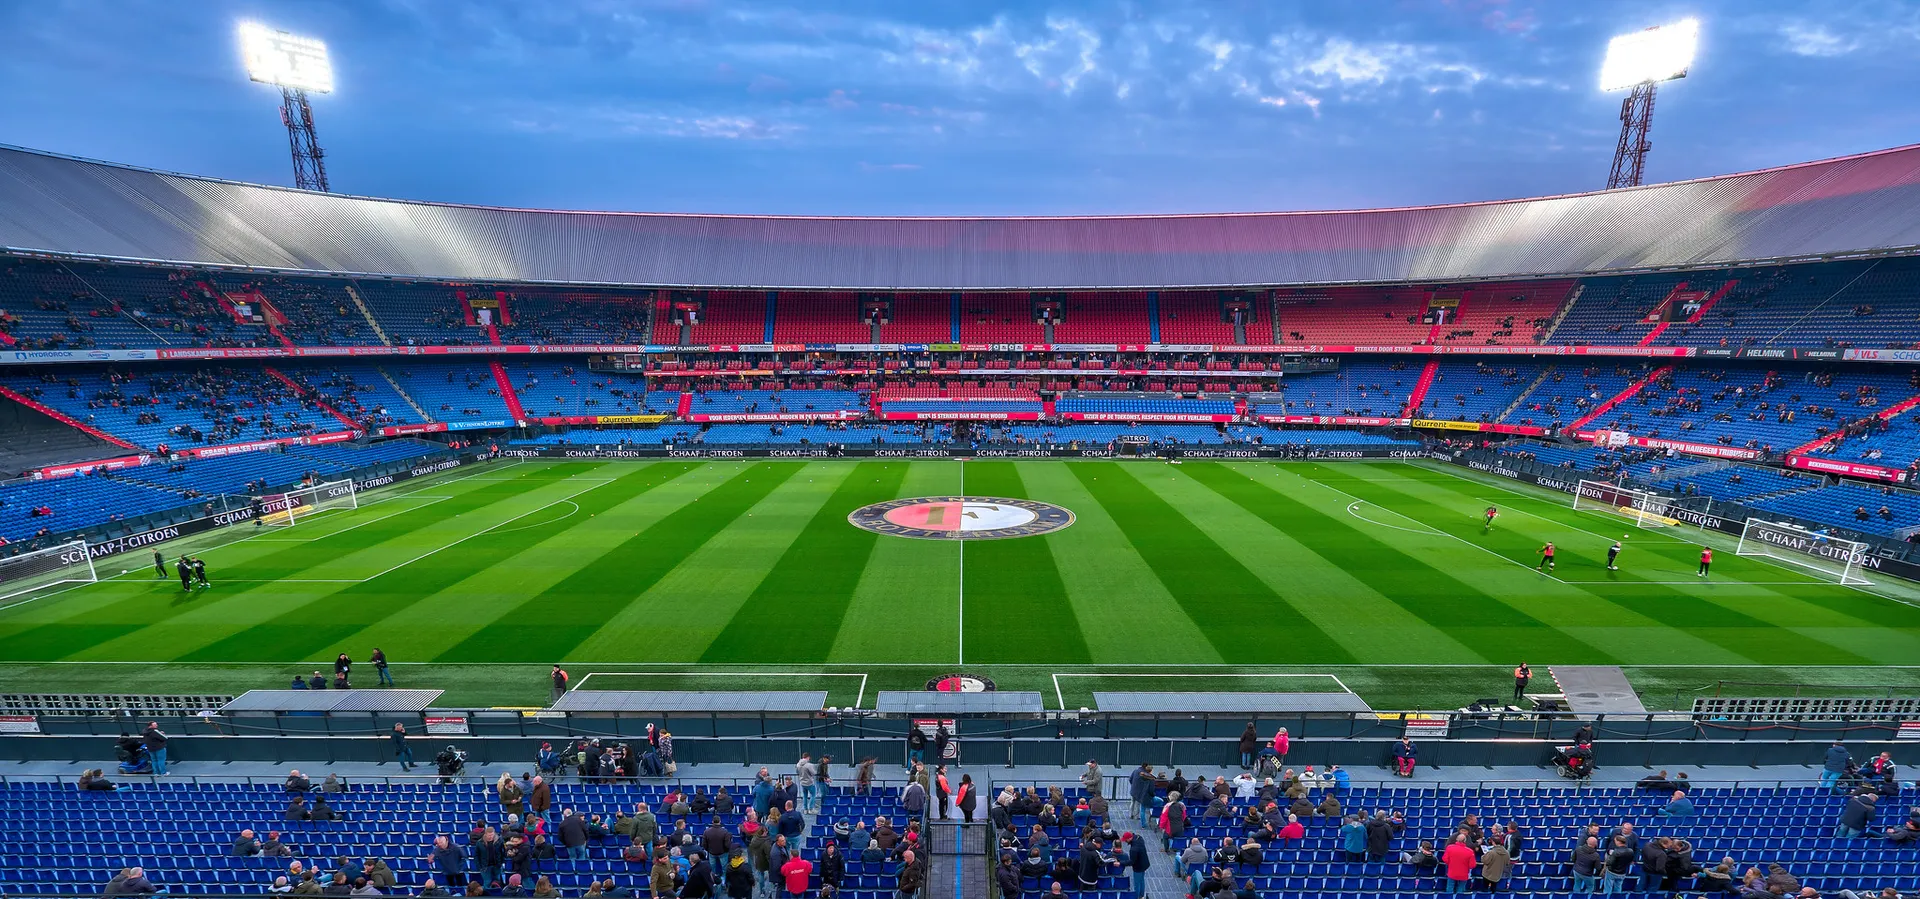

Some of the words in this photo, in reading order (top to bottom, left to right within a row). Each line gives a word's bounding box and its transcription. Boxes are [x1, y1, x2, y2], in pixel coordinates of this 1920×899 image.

[1861, 350, 1879, 359] VLS
[1414, 420, 1447, 428] Qurrent
[1389, 450, 1423, 458] SCHAAP
[1647, 440, 1671, 449] WILLEM
[1685, 445, 1718, 455] HANEGEM
[411, 463, 434, 477] SCHAAP
[1468, 460, 1490, 471] SCHAAP
[328, 482, 359, 497] SCHAAP
[1536, 476, 1565, 490] SCHAAP
[1632, 499, 1668, 514] SCHAAP
[213, 508, 253, 526] SCHAAP
[868, 519, 1062, 539] ROTTERDAM
[1757, 529, 1806, 550] SCHAAP
[60, 542, 115, 565] SCHAAP
